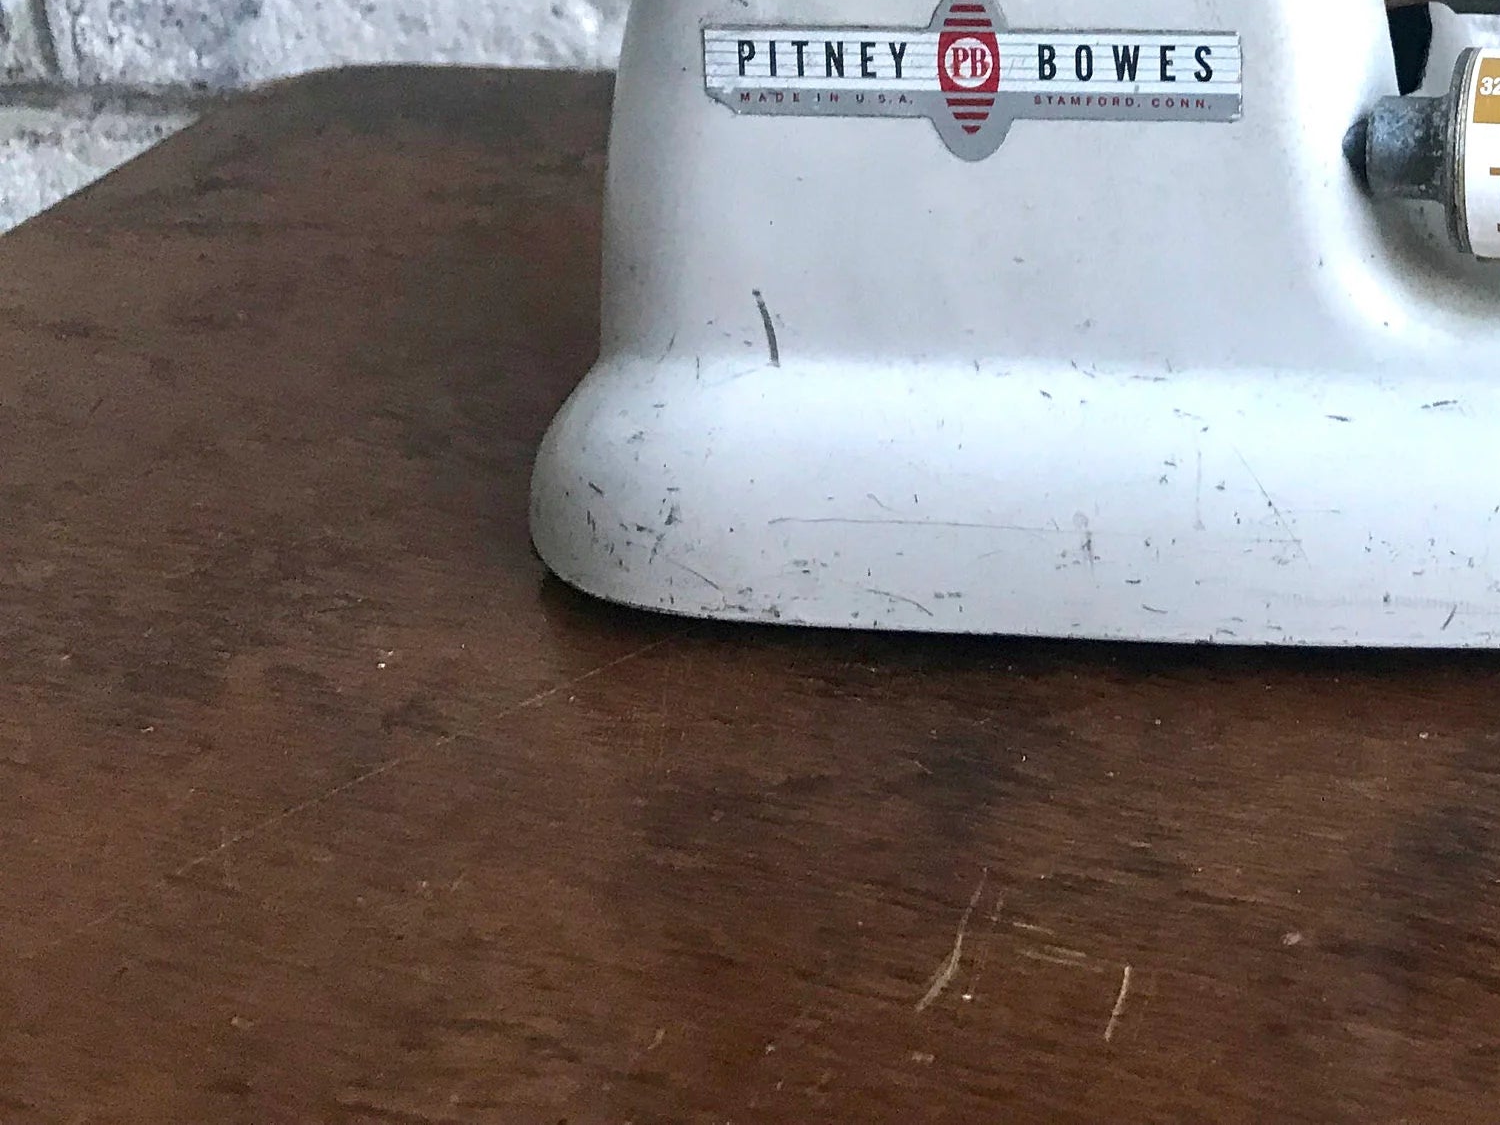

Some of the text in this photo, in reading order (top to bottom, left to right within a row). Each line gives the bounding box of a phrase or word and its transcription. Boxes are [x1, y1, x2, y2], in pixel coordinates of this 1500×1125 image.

[737, 40, 1214, 82] PITNEY PB BOWES
[740, 92, 800, 104] MADE
[816, 92, 839, 103] IN
